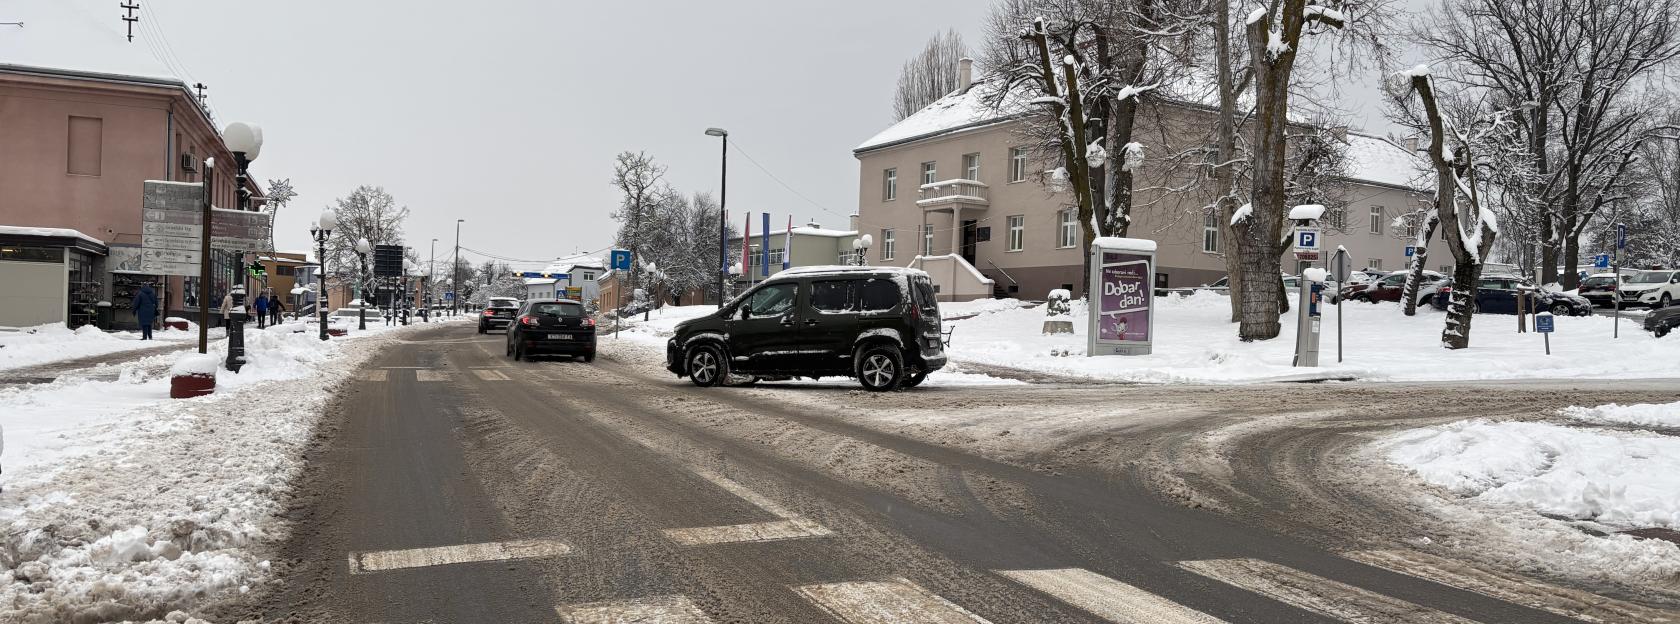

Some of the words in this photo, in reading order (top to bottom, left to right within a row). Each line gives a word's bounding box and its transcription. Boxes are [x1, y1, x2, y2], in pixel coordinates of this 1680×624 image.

[1303, 234, 1312, 245] P
[616, 253, 625, 266] P
[1598, 256, 1604, 265] P
[1105, 280, 1140, 296] Dobar
[1119, 289, 1145, 308] dan!
